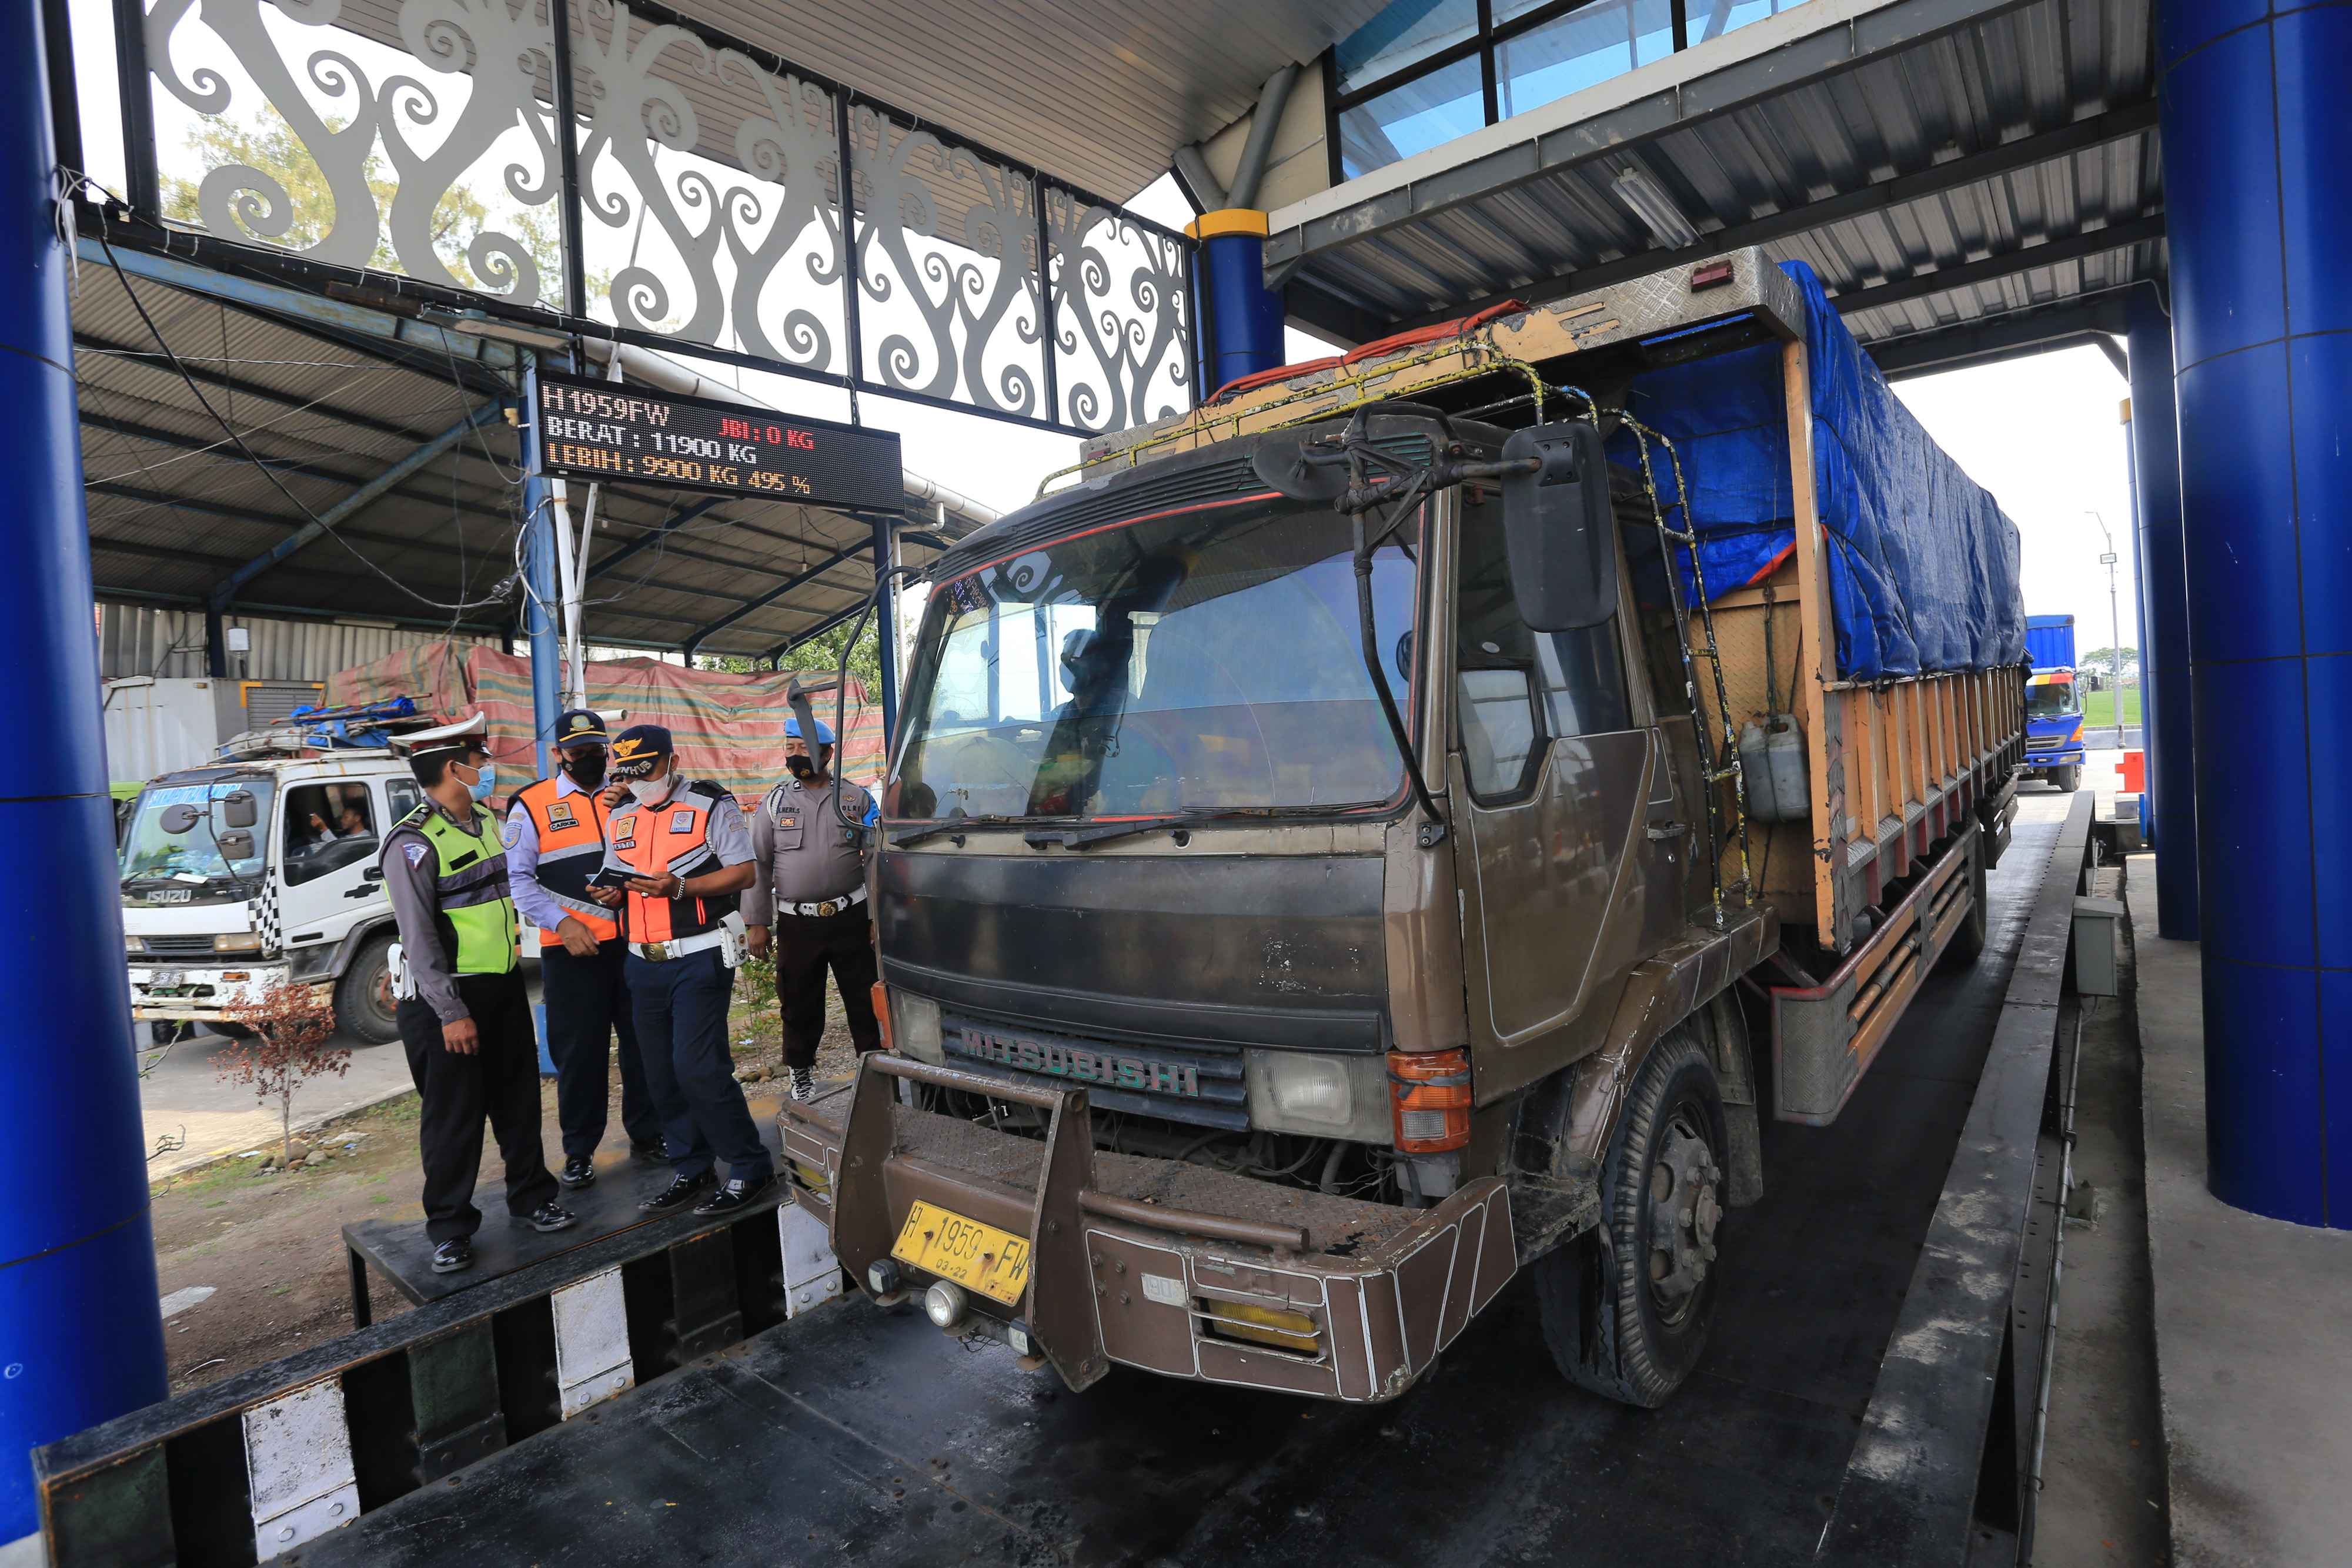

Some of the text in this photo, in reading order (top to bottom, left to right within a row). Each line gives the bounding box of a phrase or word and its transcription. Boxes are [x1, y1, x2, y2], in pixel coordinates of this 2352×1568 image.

[547, 416, 627, 445] BERAT
[650, 432, 721, 459] 11900
[729, 443, 757, 464] KG
[719, 418, 750, 440] JBI
[766, 426, 782, 444] 0
[787, 429, 815, 450] KG
[549, 443, 621, 471] LEBIH
[642, 456, 702, 481] 9900
[709, 464, 738, 486] KG
[748, 470, 786, 491] 495
[792, 475, 810, 494] %
[614, 760, 653, 775] ENHUB
[147, 890, 192, 904] ISUZU
[960, 1028, 1199, 1097] MITSUBISHI
[904, 1205, 1030, 1281] H 1959 FW
